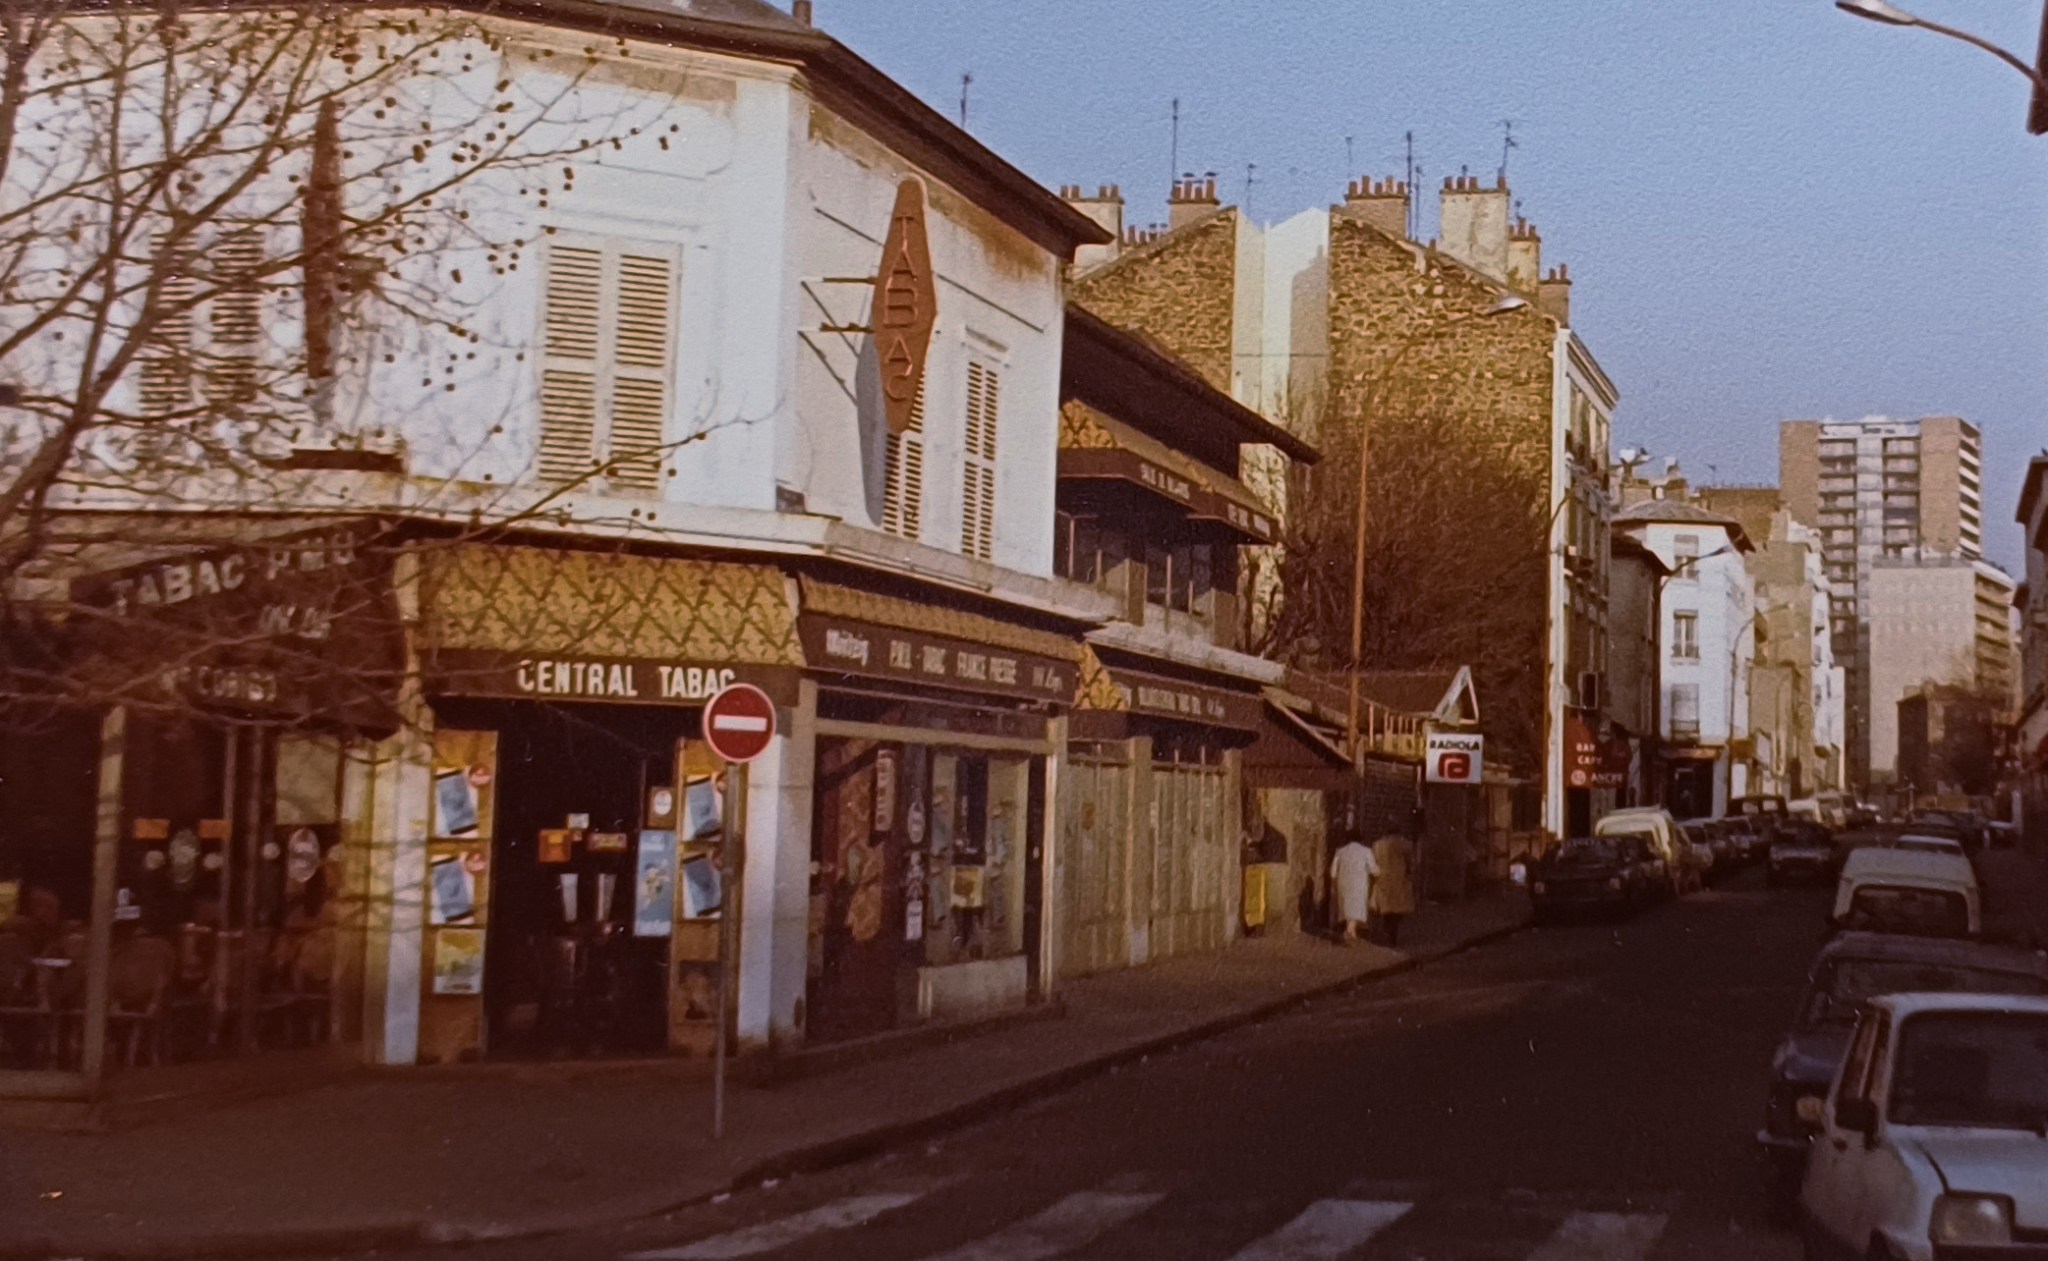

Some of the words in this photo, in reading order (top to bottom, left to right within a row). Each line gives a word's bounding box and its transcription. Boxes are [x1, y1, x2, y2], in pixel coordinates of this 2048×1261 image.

[883, 215, 918, 401] TABAC
[112, 553, 247, 616] TABAC
[517, 659, 639, 697] CENTRAL
[1429, 740, 1480, 751] RADIOLA
